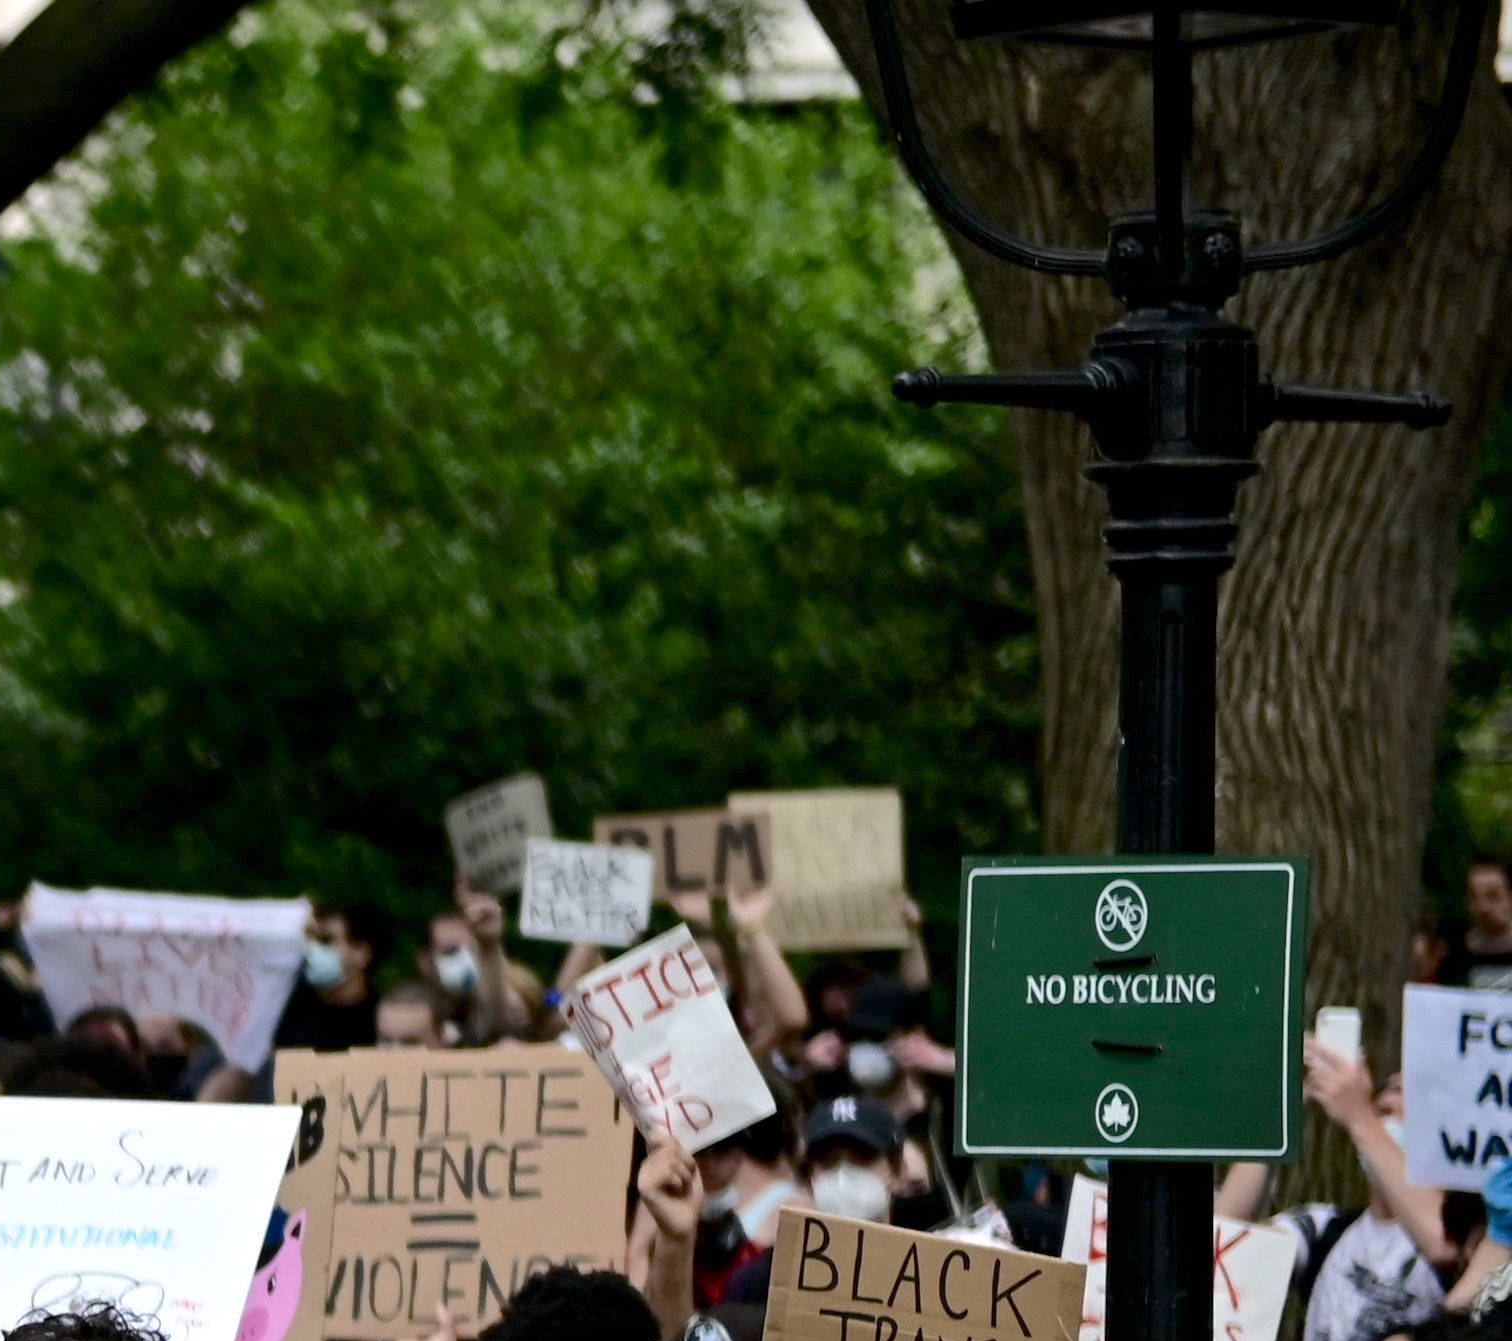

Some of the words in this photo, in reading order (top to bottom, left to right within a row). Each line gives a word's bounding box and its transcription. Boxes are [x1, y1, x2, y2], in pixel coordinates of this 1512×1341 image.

[1025, 975, 1065, 1004] NO
[1072, 973, 1216, 1005] BICYCLING
[27, 1156, 97, 1185] AND
[113, 1129, 221, 1188] SERVE
[335, 1141, 543, 1205] SILENCE
[1440, 1128, 1512, 1168] WA
[324, 1253, 599, 1322] VIOLEN
[798, 1217, 1042, 1338] BLACK
